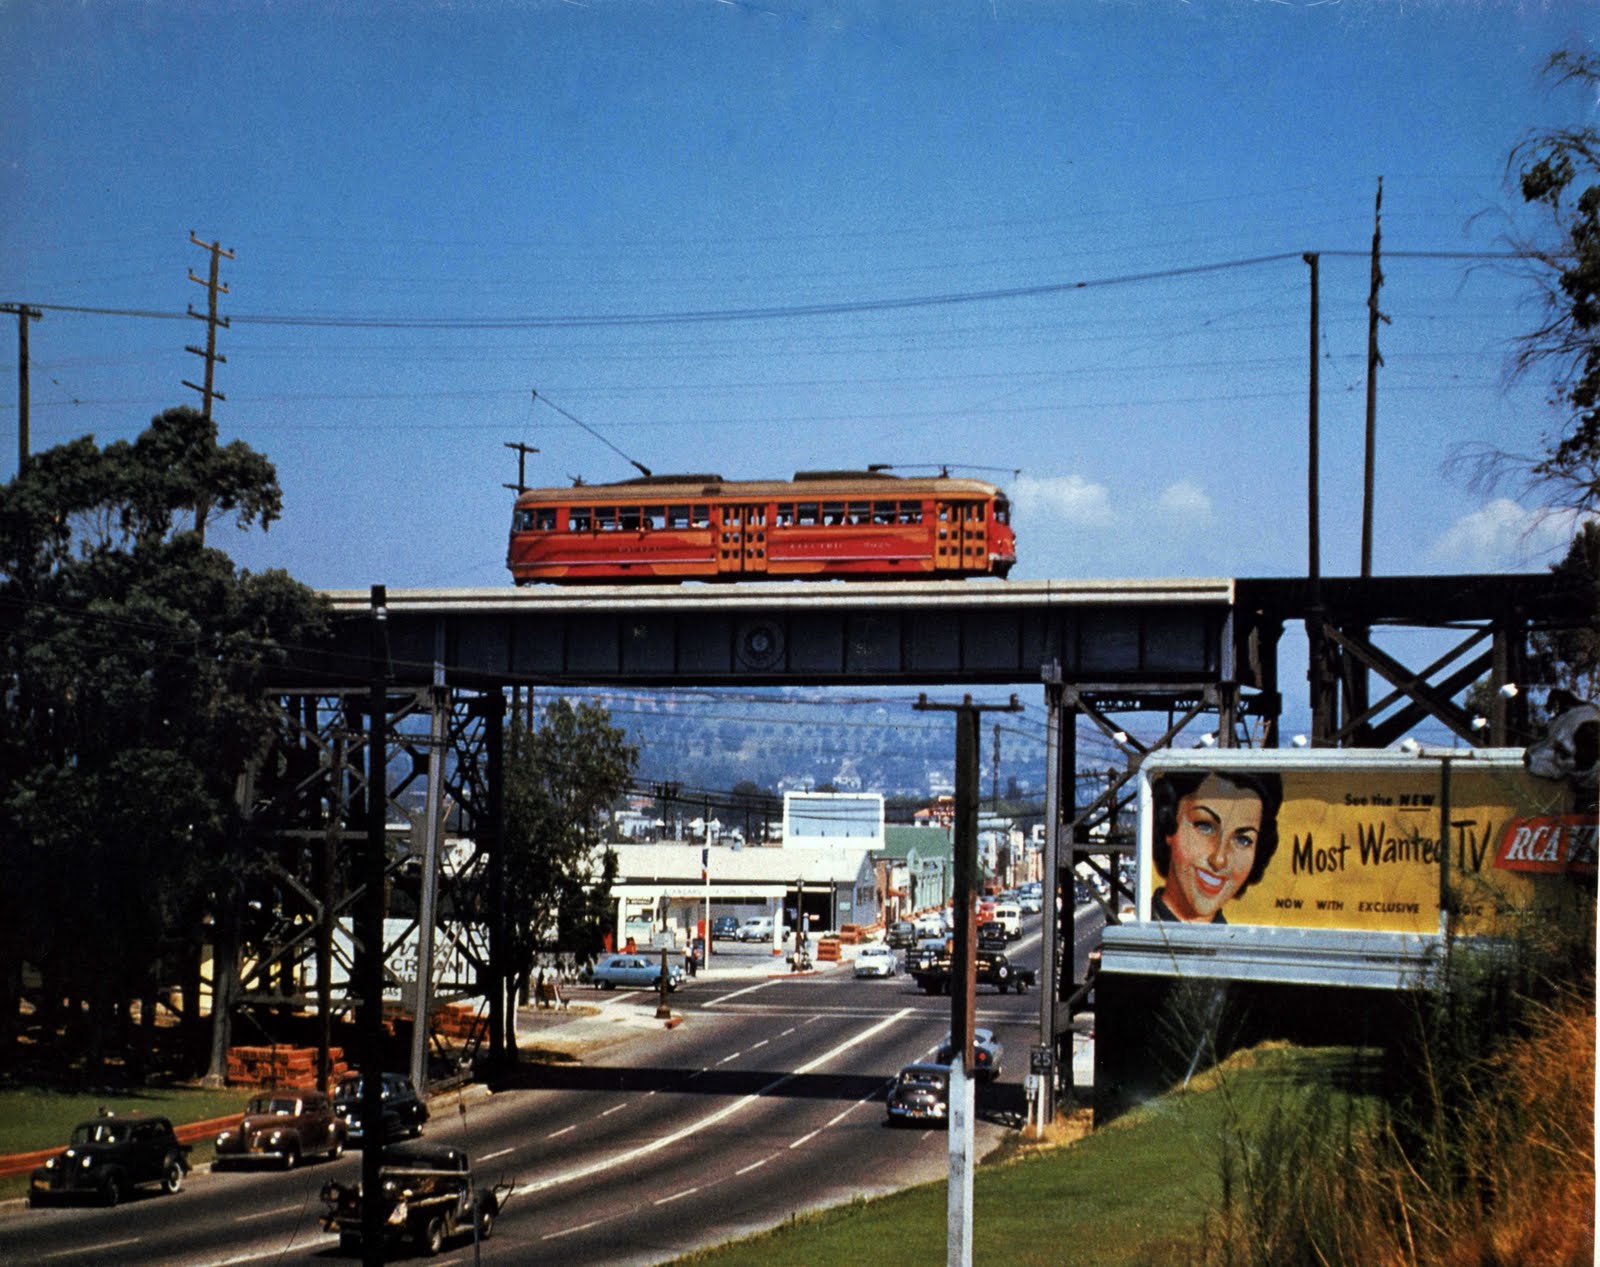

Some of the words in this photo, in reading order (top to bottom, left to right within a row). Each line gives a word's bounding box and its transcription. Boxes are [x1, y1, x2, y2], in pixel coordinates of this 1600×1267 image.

[1344, 793, 1368, 806] See
[1372, 793, 1393, 806] the
[1400, 794, 1435, 806] NEW
[1292, 832, 1351, 875] Most
[1451, 820, 1492, 874] TV
[1505, 826, 1562, 861] RCA
[1276, 898, 1304, 909] NOW
[1316, 900, 1344, 911] WITH
[1358, 902, 1420, 914] EXCLUSIVE
[390, 958, 463, 975] CRAM
[1033, 1053, 1052, 1067] 25
